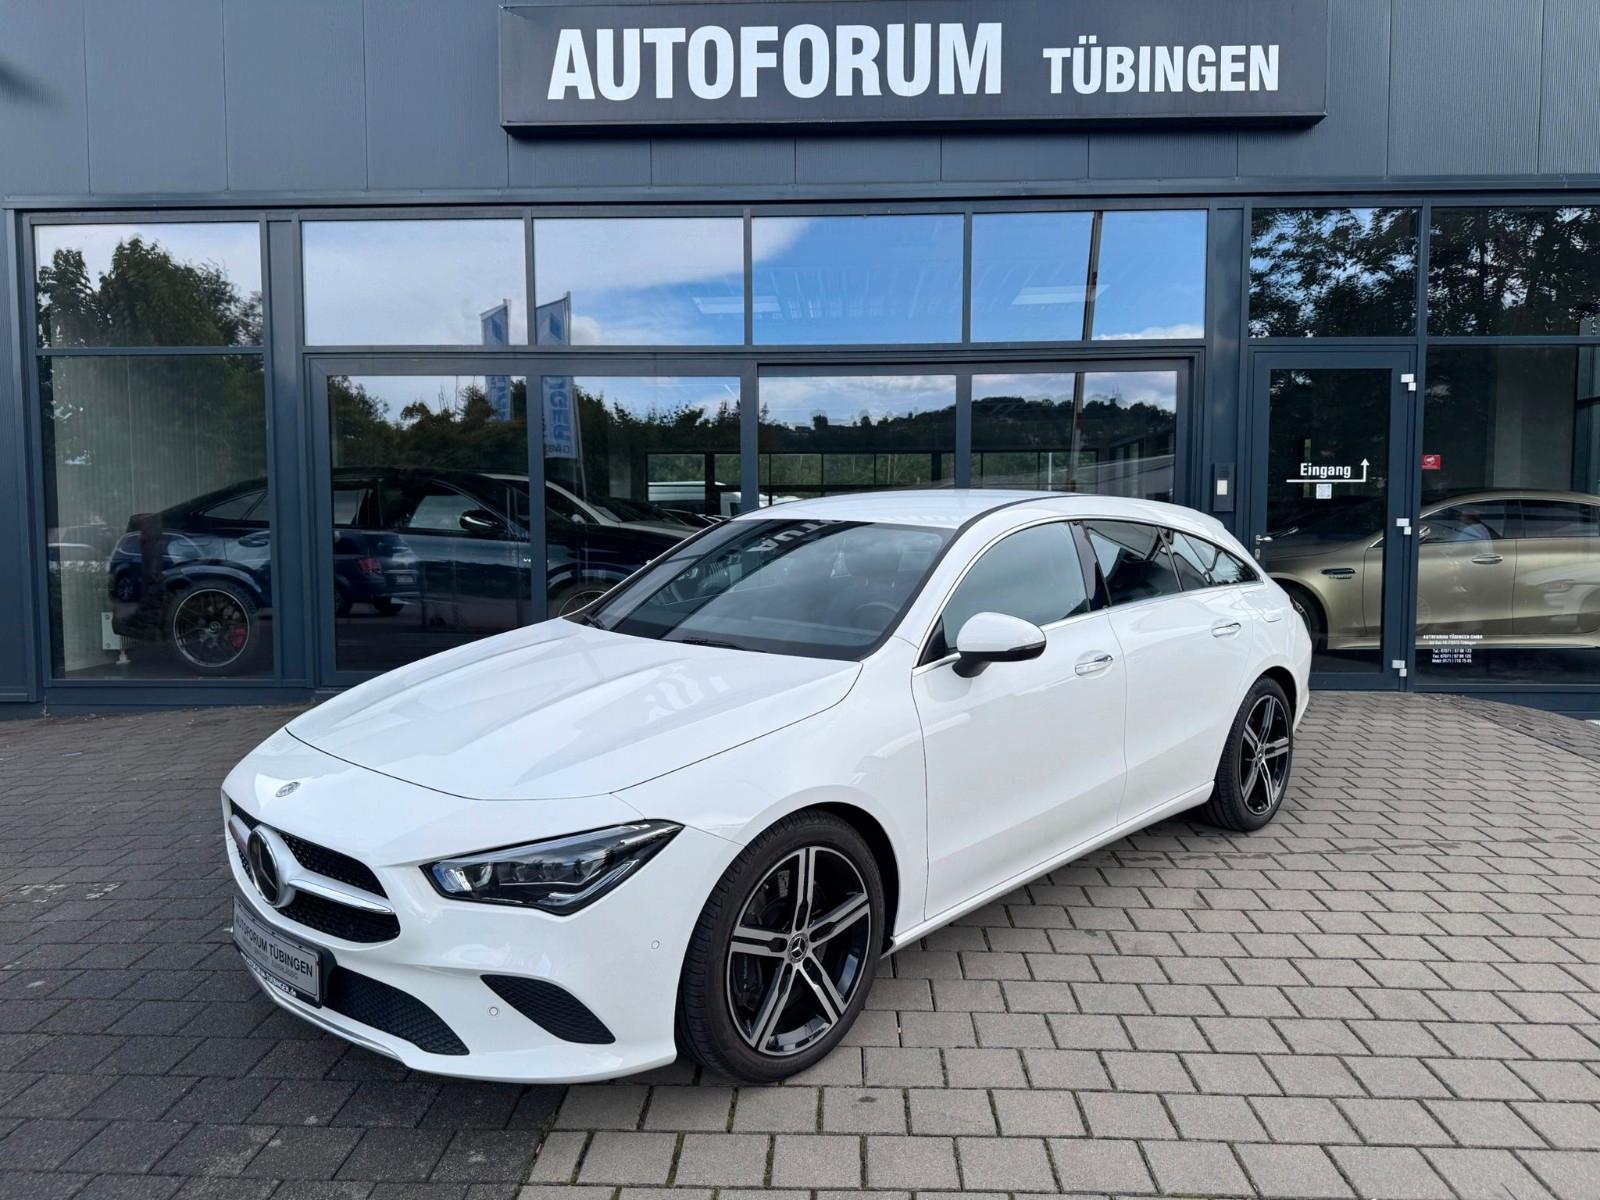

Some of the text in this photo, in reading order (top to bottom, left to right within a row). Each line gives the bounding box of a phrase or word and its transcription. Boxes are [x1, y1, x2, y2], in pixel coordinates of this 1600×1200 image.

[548, 23, 1279, 100] AUTOFORUM TÜBINGEN
[1300, 462, 1351, 478] Eingang
[269, 943, 313, 977] TÜBINGEN
